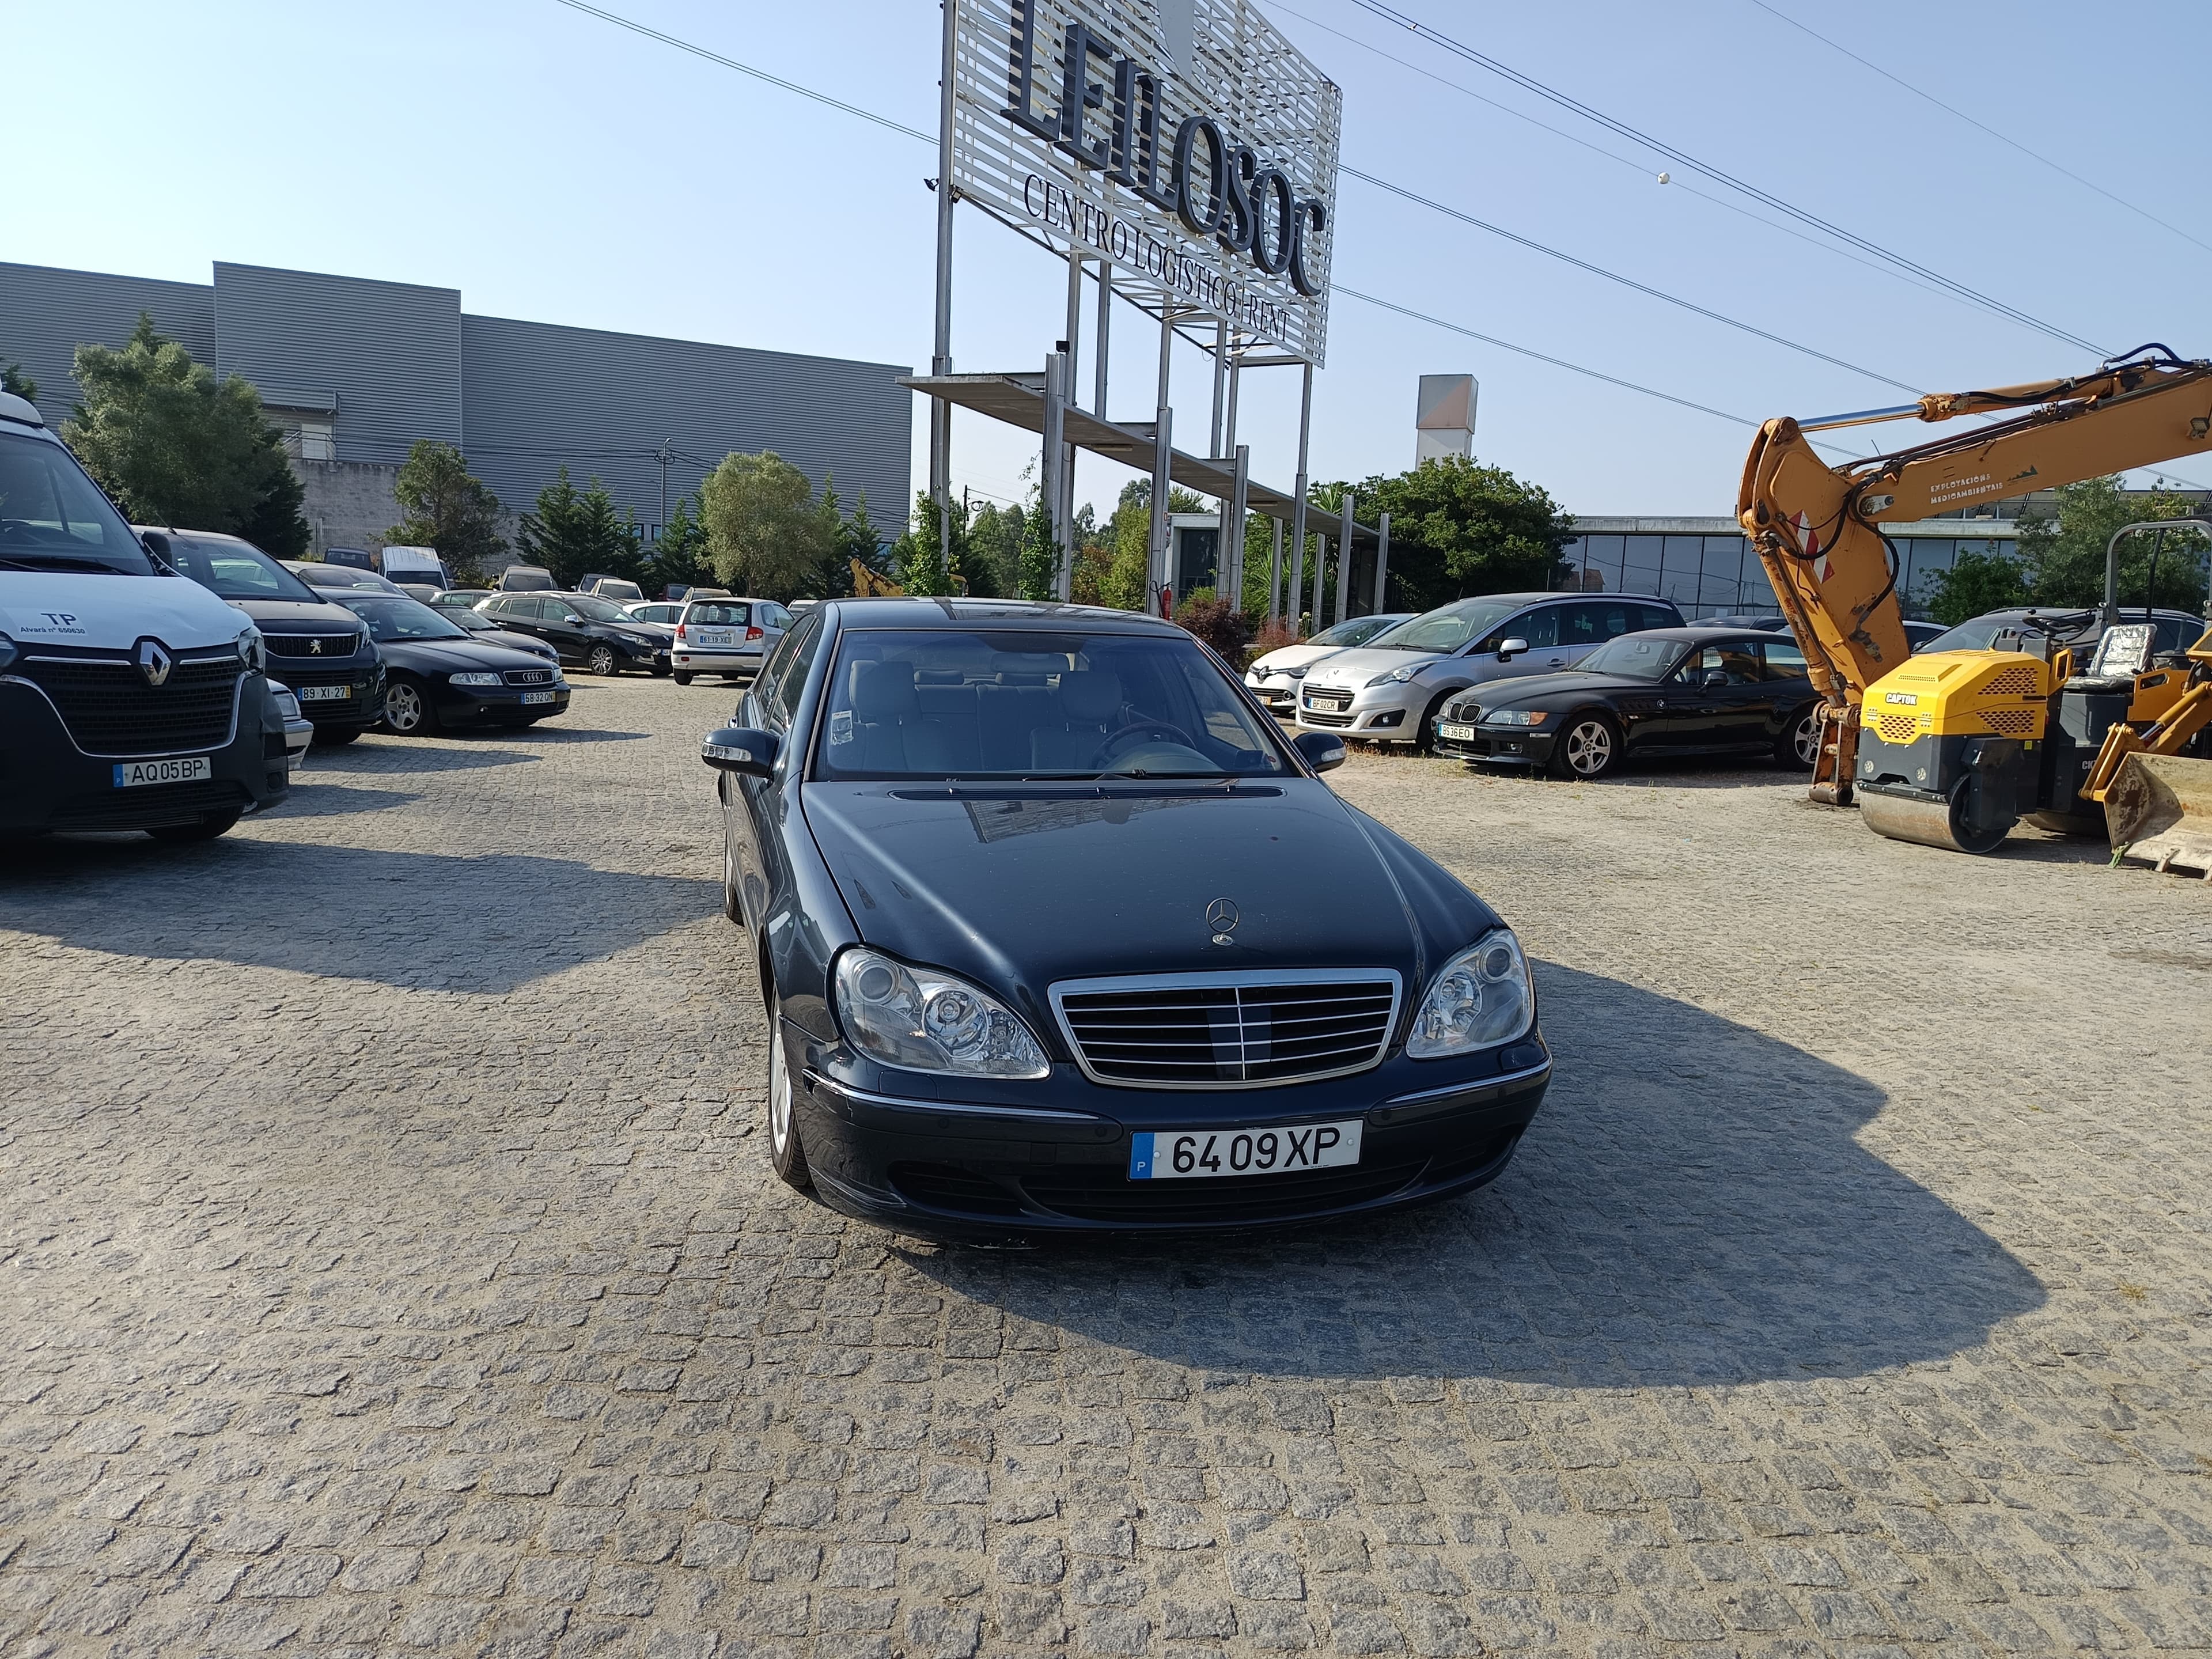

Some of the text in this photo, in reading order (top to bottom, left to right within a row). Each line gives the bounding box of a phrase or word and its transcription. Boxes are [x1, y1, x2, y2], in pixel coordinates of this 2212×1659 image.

[1001, 0, 1325, 297] LEILOSOC
[1024, 174, 1127, 260] CENTRO
[1134, 230, 1236, 316] LOGÍSTICO
[1248, 294, 1290, 342] RENT
[1930, 483, 2003, 505] MEDIOAMBIENTAIS
[40, 613, 77, 626] TP
[1885, 692, 1918, 706] CAPTOK
[2082, 760, 2097, 770] CK
[1137, 1161, 1146, 1172] P
